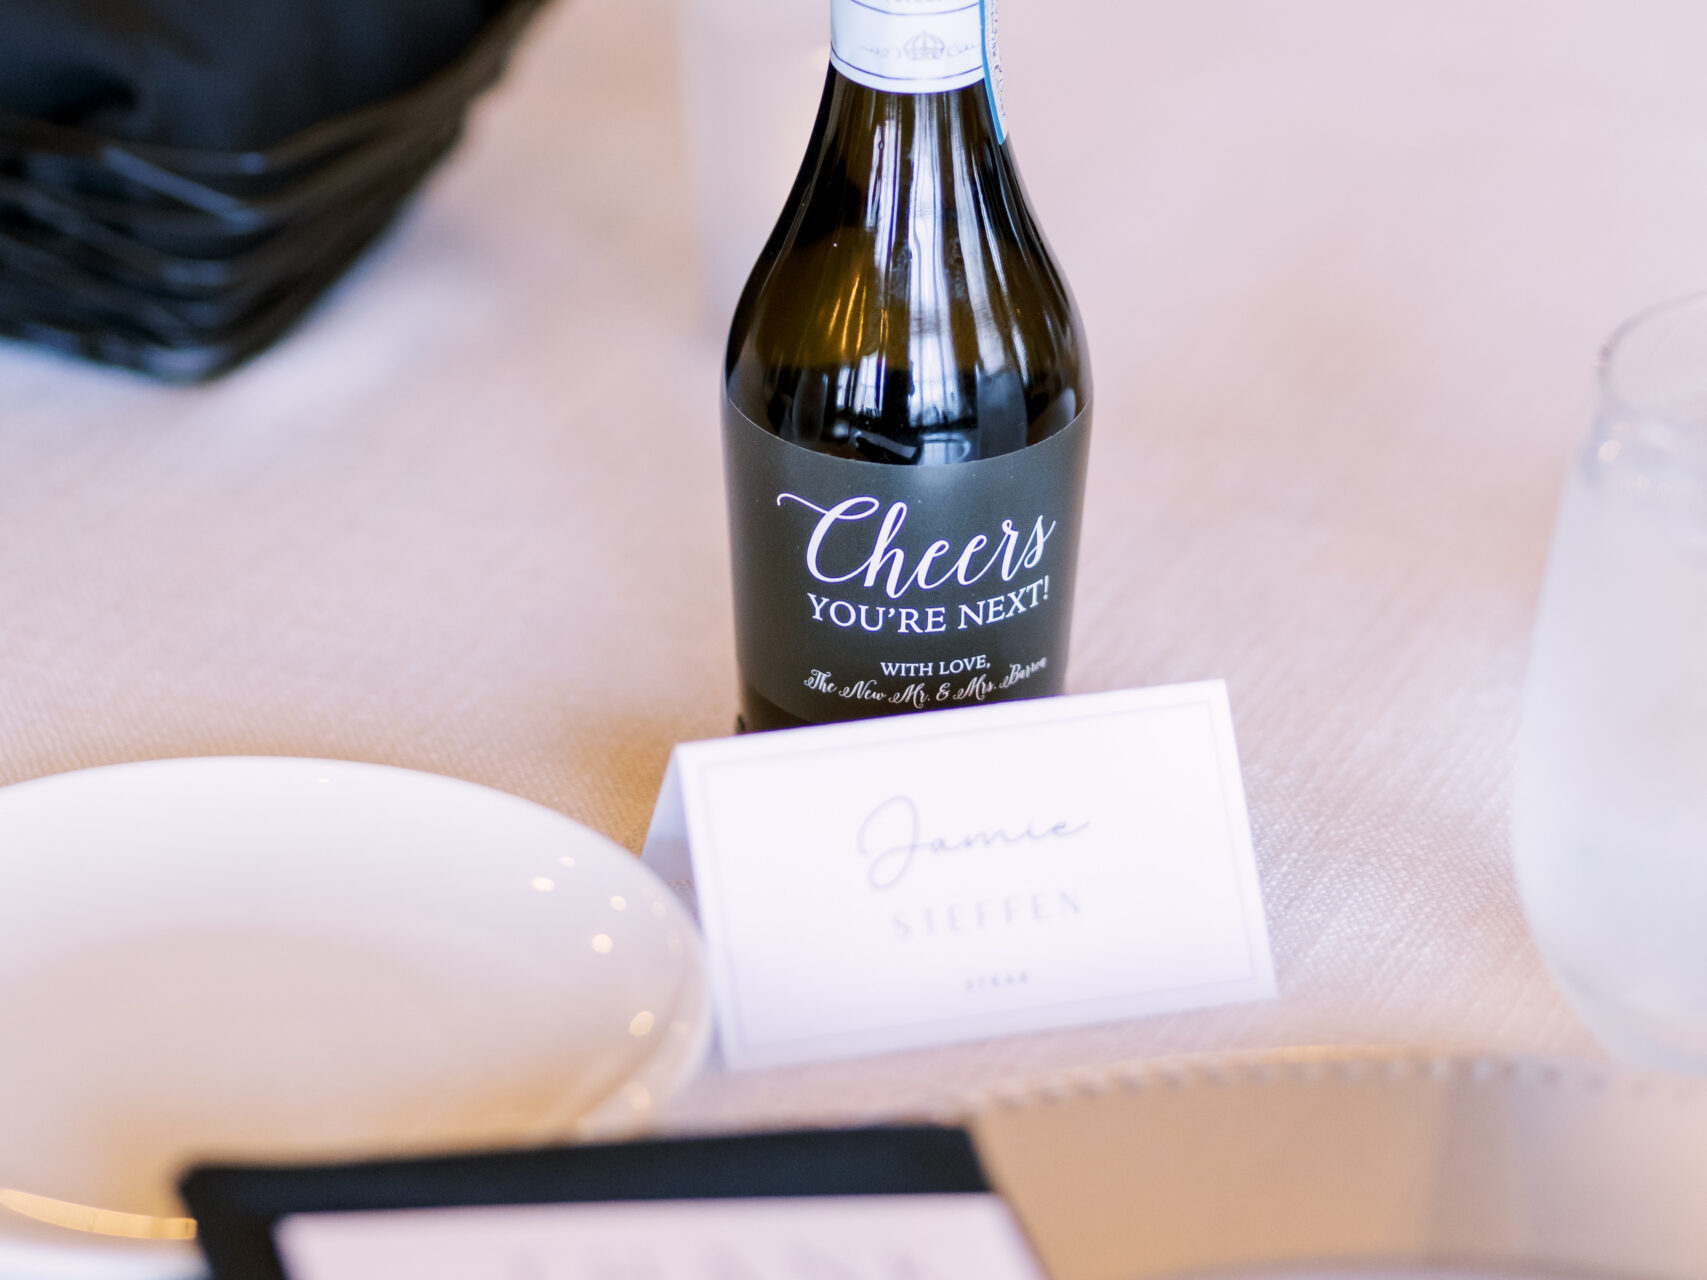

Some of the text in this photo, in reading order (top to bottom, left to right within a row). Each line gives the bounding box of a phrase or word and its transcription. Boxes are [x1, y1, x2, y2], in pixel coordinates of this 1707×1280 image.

[777, 492, 1056, 599] Cheers
[806, 574, 1050, 634] YOU'RE NEXT!
[803, 668, 837, 693] The
[838, 679, 886, 700] New
[888, 682, 930, 709] Mr.
[935, 682, 951, 701] &
[952, 673, 997, 701] Mrs.
[880, 654, 991, 677] WITH LOVE,
[856, 794, 1089, 891] Jamie
